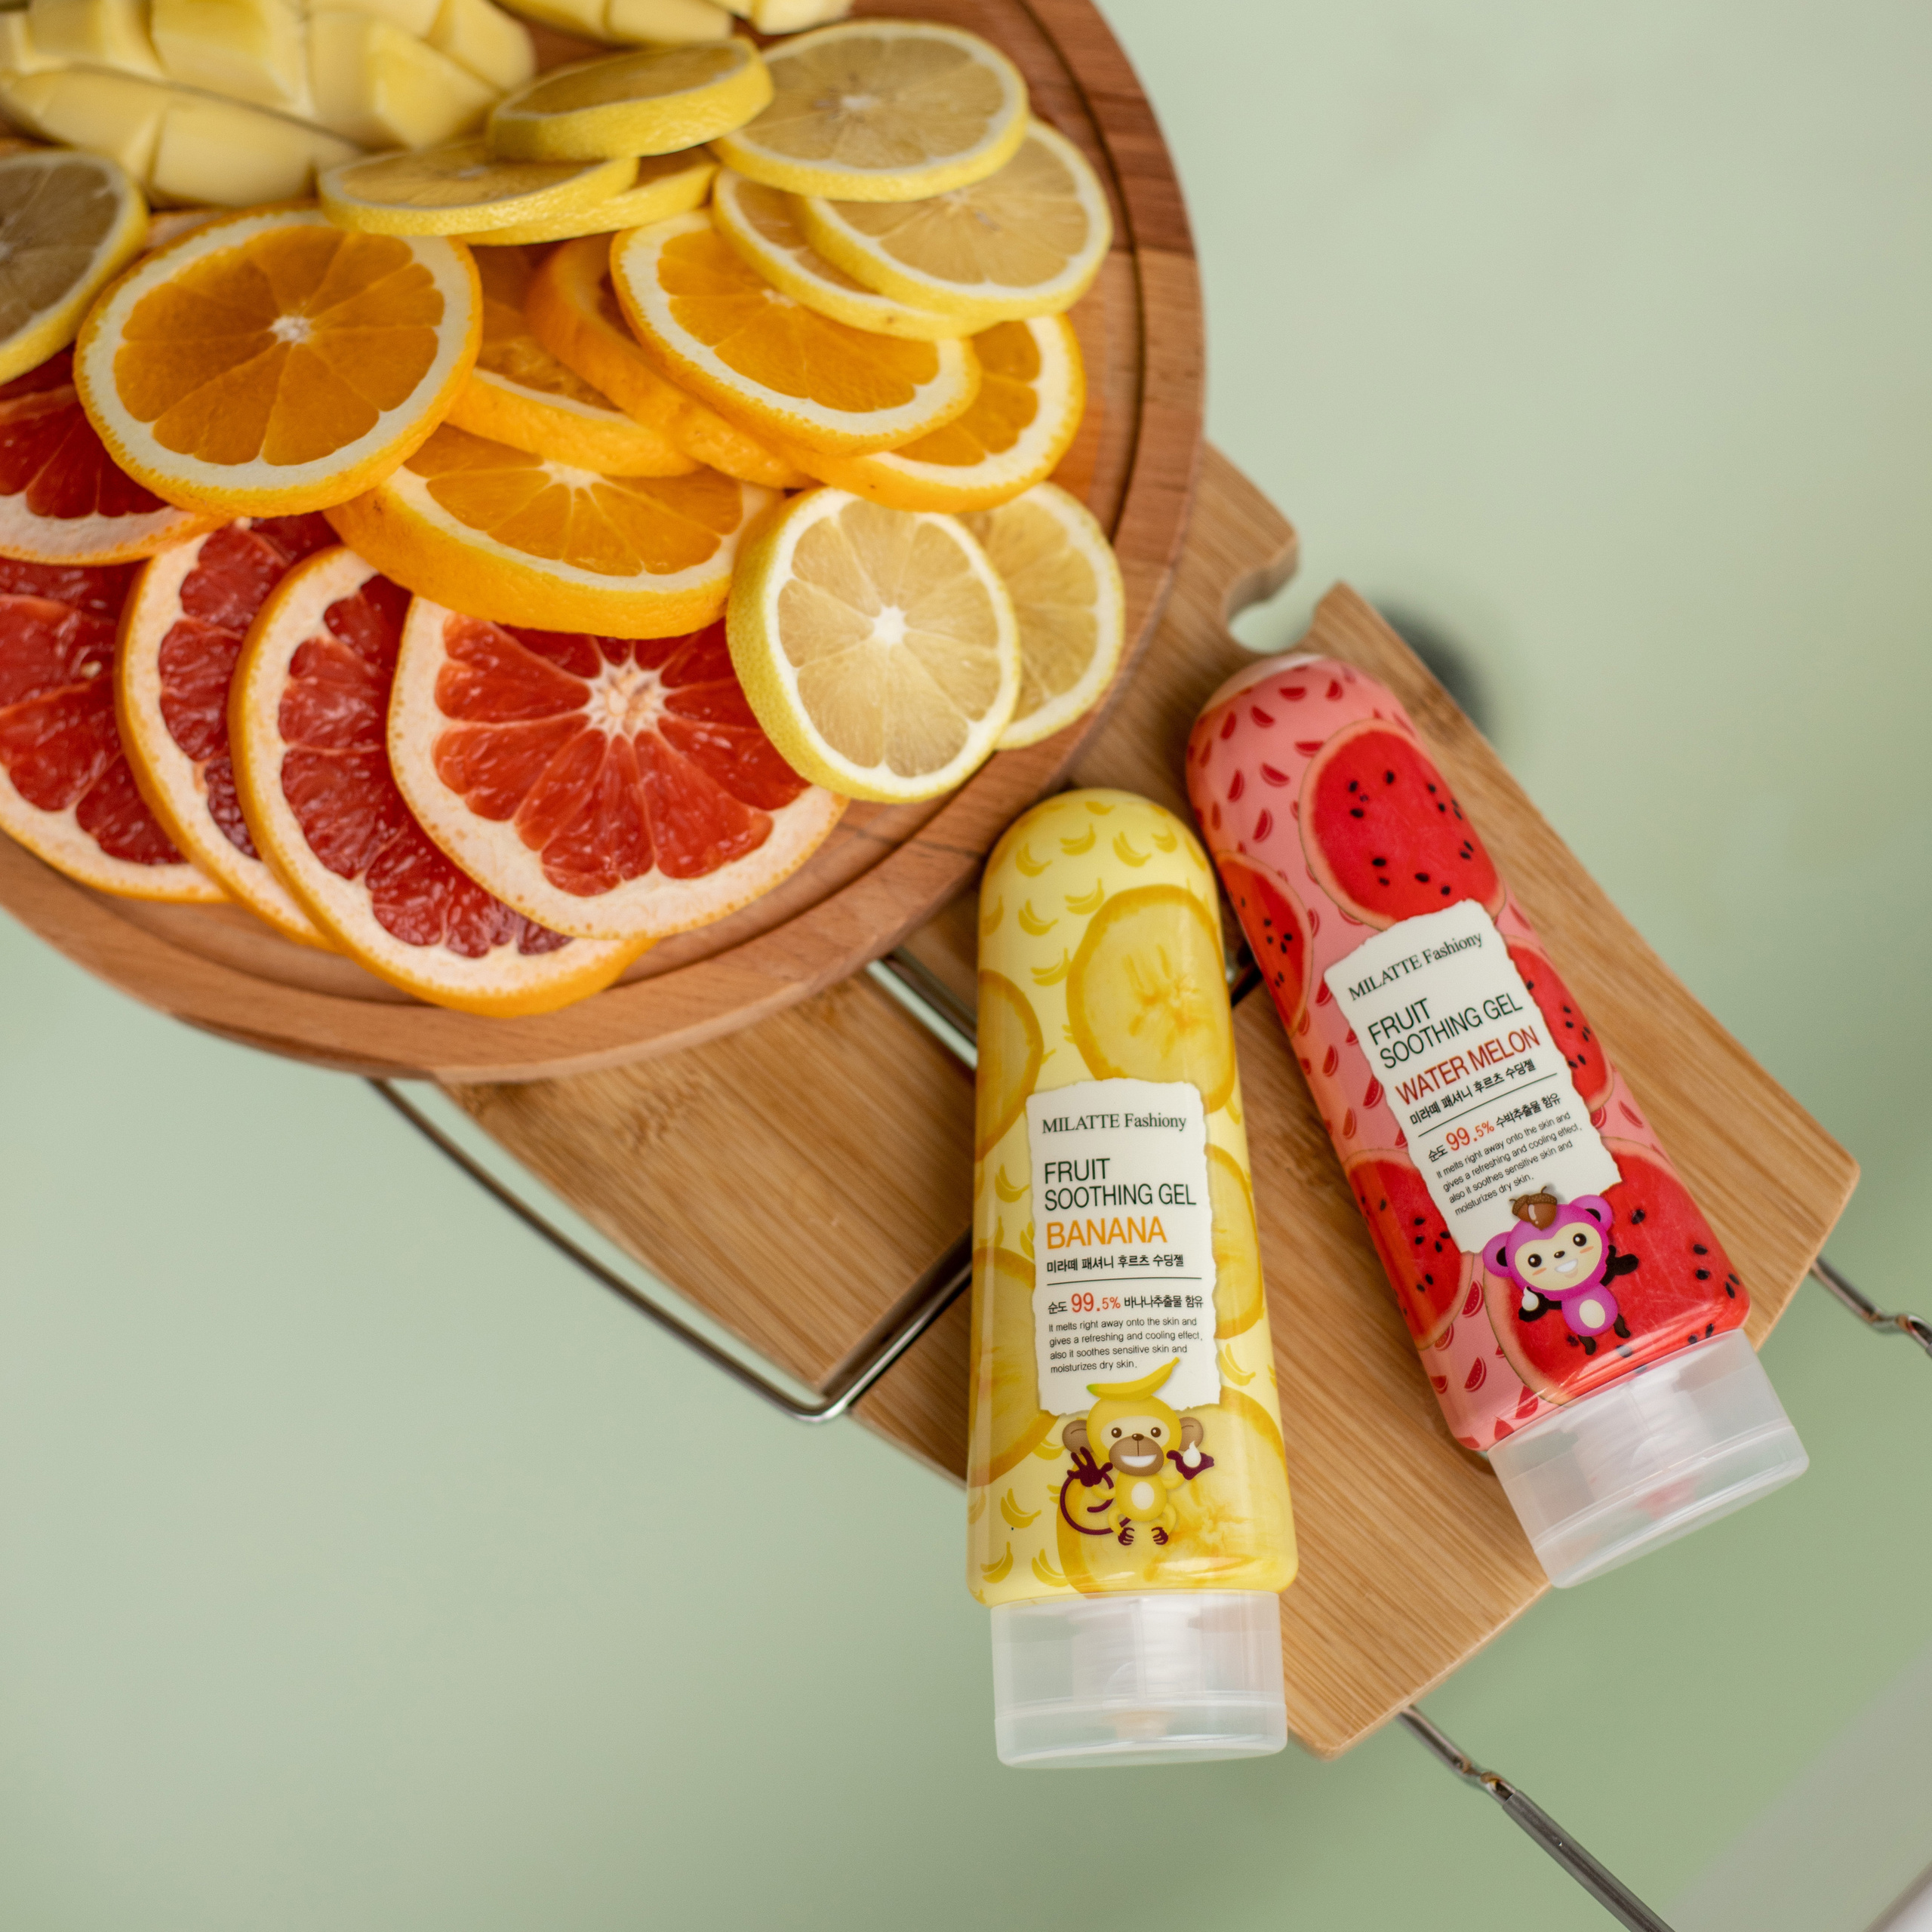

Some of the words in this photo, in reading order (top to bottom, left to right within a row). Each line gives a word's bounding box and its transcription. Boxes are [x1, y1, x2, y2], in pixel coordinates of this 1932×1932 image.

[1347, 954, 1423, 1001] MILATTE
[1421, 933, 1482, 964] Fashiony
[1367, 997, 1431, 1046] FRUIT
[1380, 1007, 1484, 1069] SOOTHING
[1482, 992, 1524, 1020] GEL
[1394, 1055, 1470, 1106] WATER
[1466, 1025, 1540, 1072] MELON
[1409, 1100, 1441, 1125] 미라떼
[1440, 1085, 1474, 1109] 패셔니
[1472, 1072, 1506, 1094] 후르츠
[1505, 1058, 1537, 1079] 수딩젤
[1041, 1113, 1120, 1134] MILATTE
[1124, 1112, 1187, 1132] Fashiony
[1428, 1144, 1448, 1163] 순도
[1445, 1120, 1495, 1152] 99.5%
[1496, 1100, 1542, 1128] 수박추출물
[1540, 1093, 1561, 1109] 함유
[1435, 1171, 1443, 1180] It
[1442, 1160, 1464, 1176] melts
[1464, 1149, 1483, 1164] right
[1483, 1140, 1505, 1155] away
[1506, 1132, 1524, 1145] onto
[1523, 1126, 1538, 1137] the
[1537, 1118, 1555, 1131] skin
[1555, 1111, 1571, 1124] and
[1442, 1176, 1464, 1193] gives
[1464, 1172, 1472, 1180] a
[1471, 1152, 1512, 1177] refreshing
[1511, 1143, 1528, 1158] and
[1527, 1133, 1558, 1150] cooling
[1044, 1158, 1111, 1185] FRUIT
[1448, 1190, 1466, 1204] also
[1465, 1186, 1472, 1195] it
[1472, 1171, 1504, 1192] soothes
[1504, 1155, 1539, 1176] sensitive
[1539, 1147, 1557, 1160] skin
[1557, 1139, 1574, 1152] and
[1044, 1183, 1153, 1212] SOOTHING
[1158, 1183, 1197, 1206] GEL
[1454, 1189, 1498, 1216] moisturizes
[1498, 1182, 1512, 1194] dry
[1512, 1174, 1534, 1187] skin.
[1046, 1216, 1168, 1251] BANANA
[1046, 1257, 1078, 1274] 미라떼
[1081, 1255, 1115, 1270] 패셔니
[1117, 1254, 1150, 1269] 후르츠
[1152, 1254, 1184, 1267] 수딩젤
[1048, 1301, 1068, 1315] 순도
[1070, 1291, 1121, 1313] 99.5%
[1124, 1294, 1183, 1309] 바나나추출물
[1184, 1294, 1204, 1309] 함유
[1048, 1324, 1054, 1333] It
[1055, 1321, 1078, 1332] melts
[1079, 1320, 1099, 1331] right
[1100, 1320, 1124, 1329] away
[1125, 1318, 1145, 1327] onto
[1146, 1317, 1161, 1326] the
[1162, 1316, 1180, 1326] skin
[1181, 1317, 1198, 1326] and
[1049, 1337, 1072, 1349] gives
[1081, 1332, 1124, 1343] refreshing
[1126, 1331, 1143, 1341] and
[1145, 1330, 1176, 1342] cooling
[1050, 1350, 1067, 1361] also
[1069, 1349, 1074, 1358] it
[1076, 1347, 1110, 1358] soothes
[1112, 1345, 1150, 1355] sensitive
[1152, 1344, 1170, 1354] skin
[1171, 1344, 1188, 1353] and
[1050, 1361, 1097, 1374] moisturizes
[1099, 1360, 1114, 1371] dry
[1115, 1359, 1137, 1369] skin.
